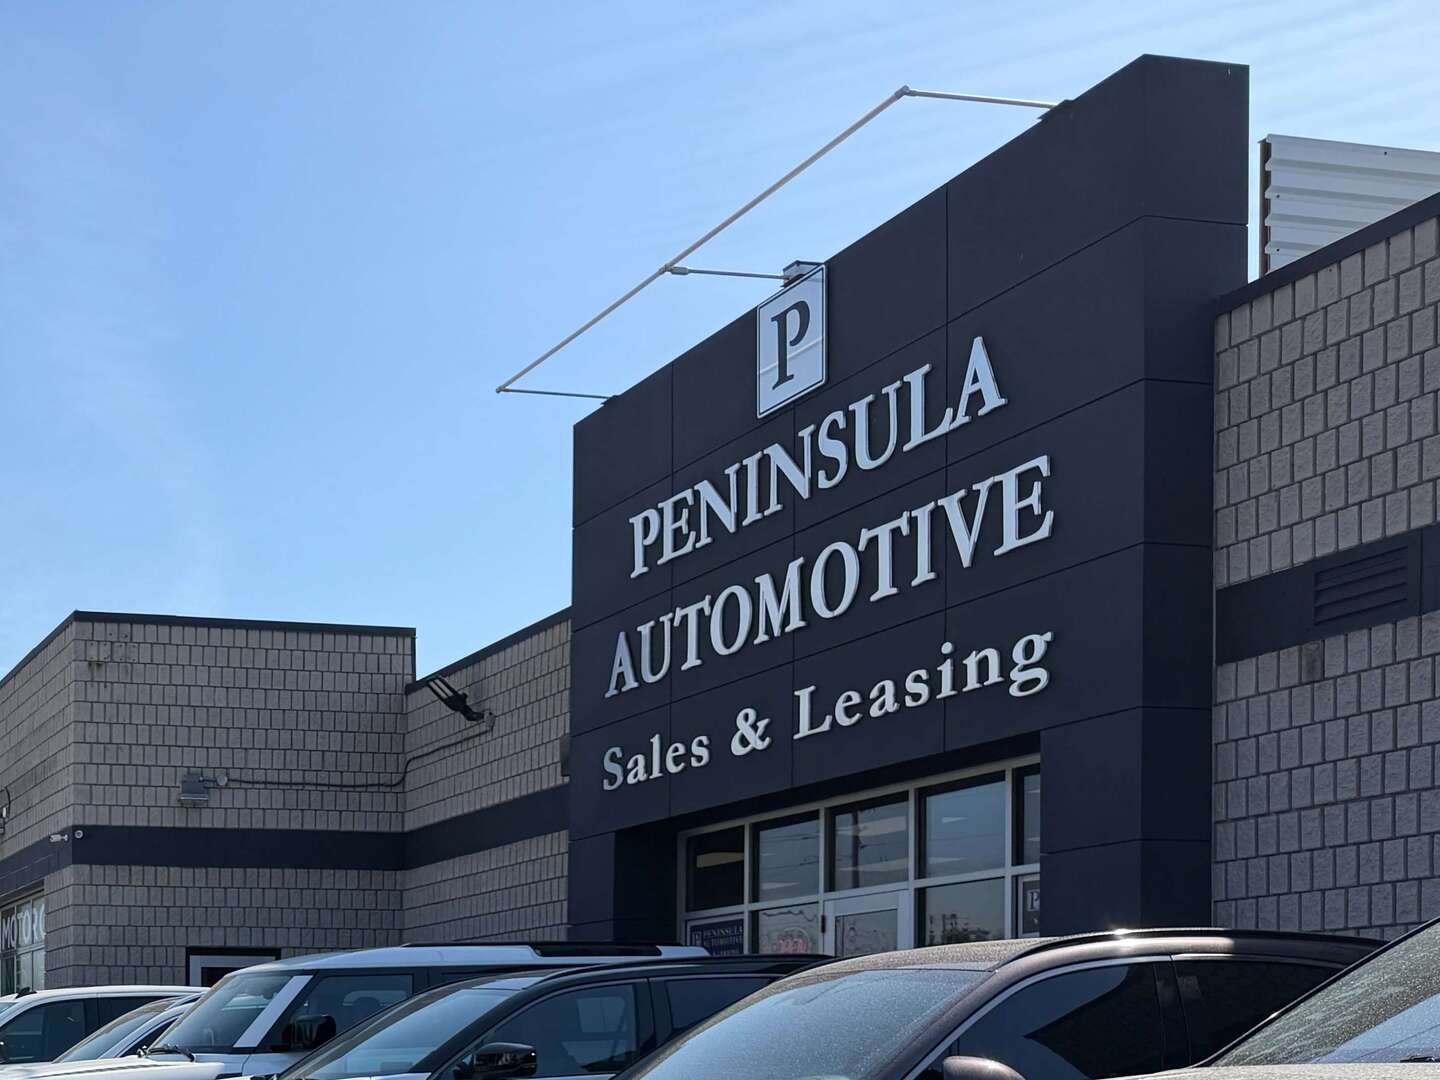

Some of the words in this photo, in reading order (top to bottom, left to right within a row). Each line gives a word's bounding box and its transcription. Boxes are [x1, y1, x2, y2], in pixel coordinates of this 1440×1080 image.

[771, 299, 811, 391] P
[629, 336, 1008, 579] PENINSULA
[604, 455, 1055, 699] AUTOMOTIVE
[602, 733, 711, 791] Sales
[730, 707, 772, 757] &
[793, 631, 1055, 740] Leasing
